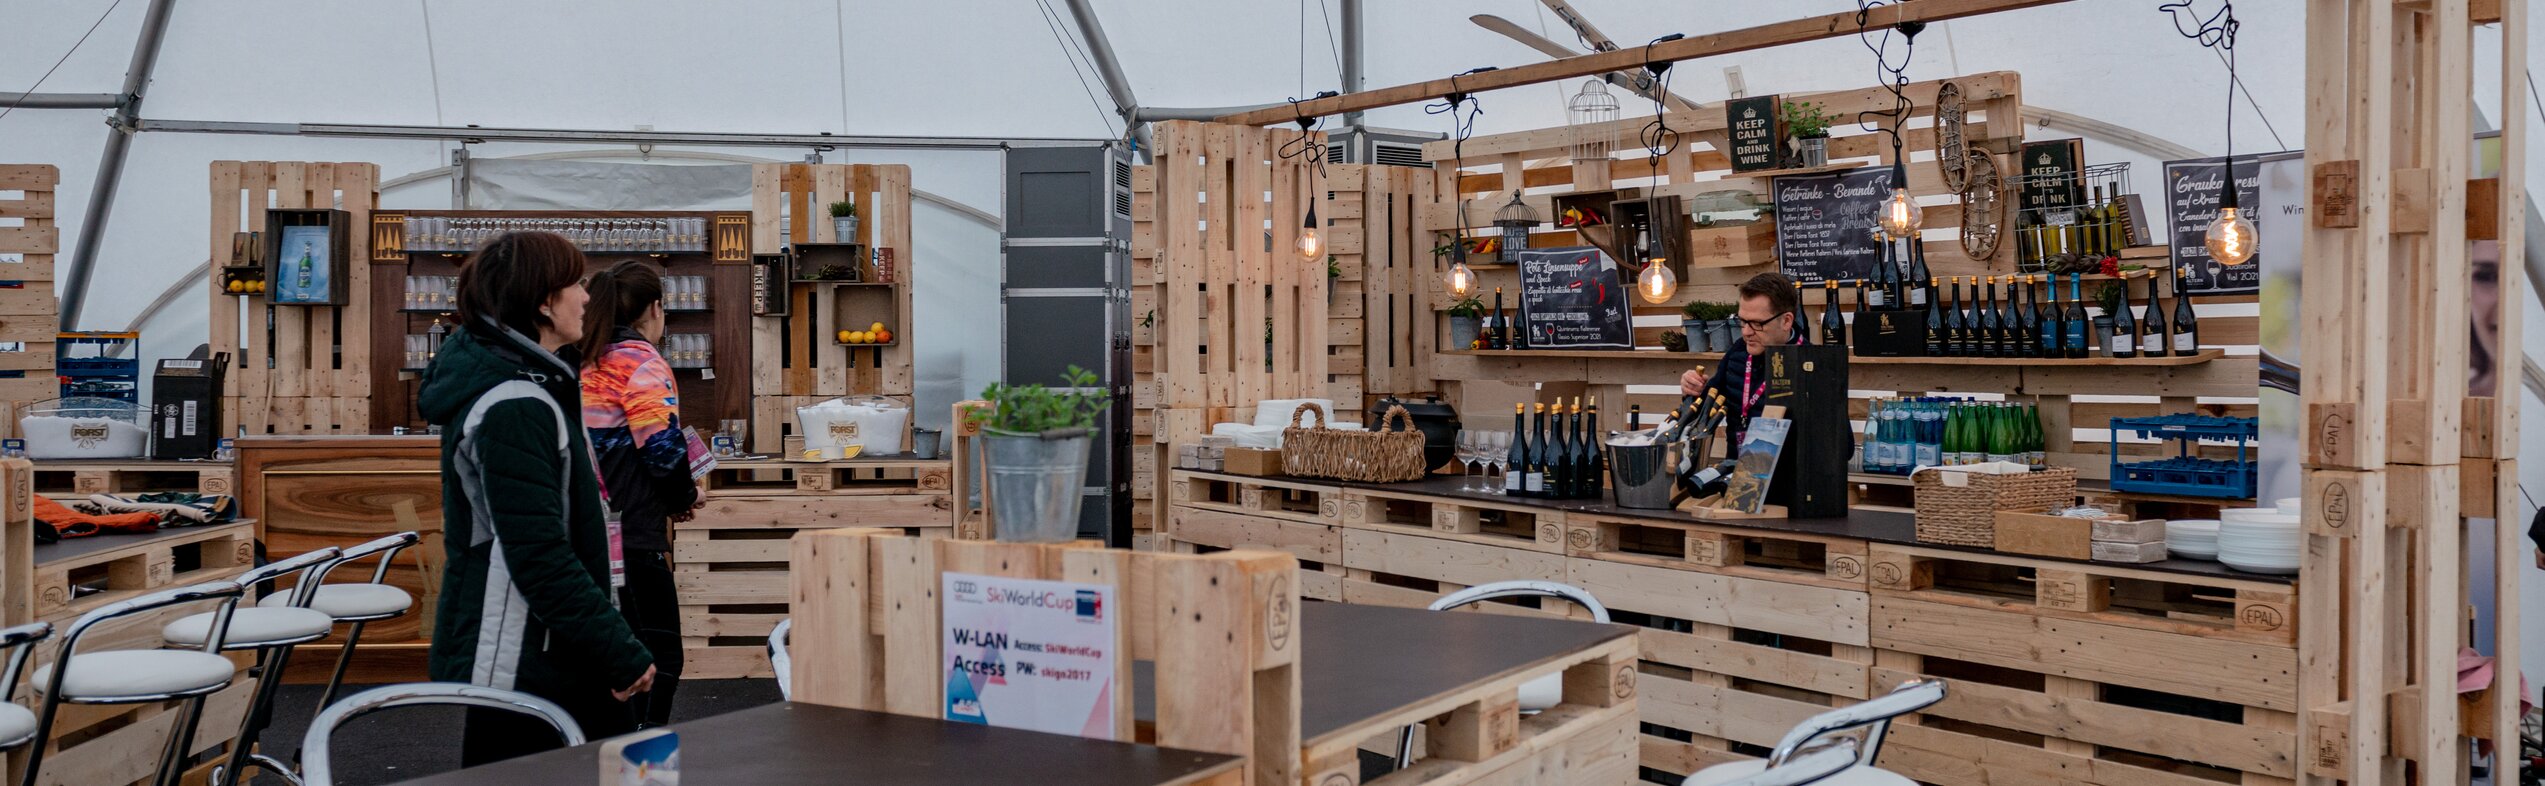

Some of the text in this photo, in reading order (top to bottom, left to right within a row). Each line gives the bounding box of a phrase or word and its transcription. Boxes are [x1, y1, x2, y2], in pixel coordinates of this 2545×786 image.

[1736, 119, 1765, 130] KEEP
[1737, 129, 1766, 139] CALM
[1737, 144, 1770, 155] DRINK
[1740, 154, 1768, 164] WINE
[2031, 166, 2061, 176] KEEP
[1834, 180, 1876, 198] Bevande
[2032, 178, 2062, 188] CALM
[2177, 194, 2192, 209] auf
[1840, 201, 1870, 218] Coffee
[2178, 209, 2216, 222] Canederli
[1842, 215, 1871, 230] Break
[1504, 237, 1526, 250] LOVE
[2240, 272, 2258, 281] 2021
[754, 276, 763, 302] KEEP
[74, 428, 106, 436] FORST
[830, 426, 856, 434] FORST
[2328, 490, 2344, 522] EPAL
[1836, 561, 1856, 576] EPAL
[987, 586, 1074, 612] SkiWorldCup
[2247, 609, 2279, 628] EPAL
[953, 628, 1008, 650] W-LAN
[1014, 640, 1102, 658] Access: SkiWorldCup
[953, 656, 1006, 677] Access
[1016, 661, 1037, 676] PW:
